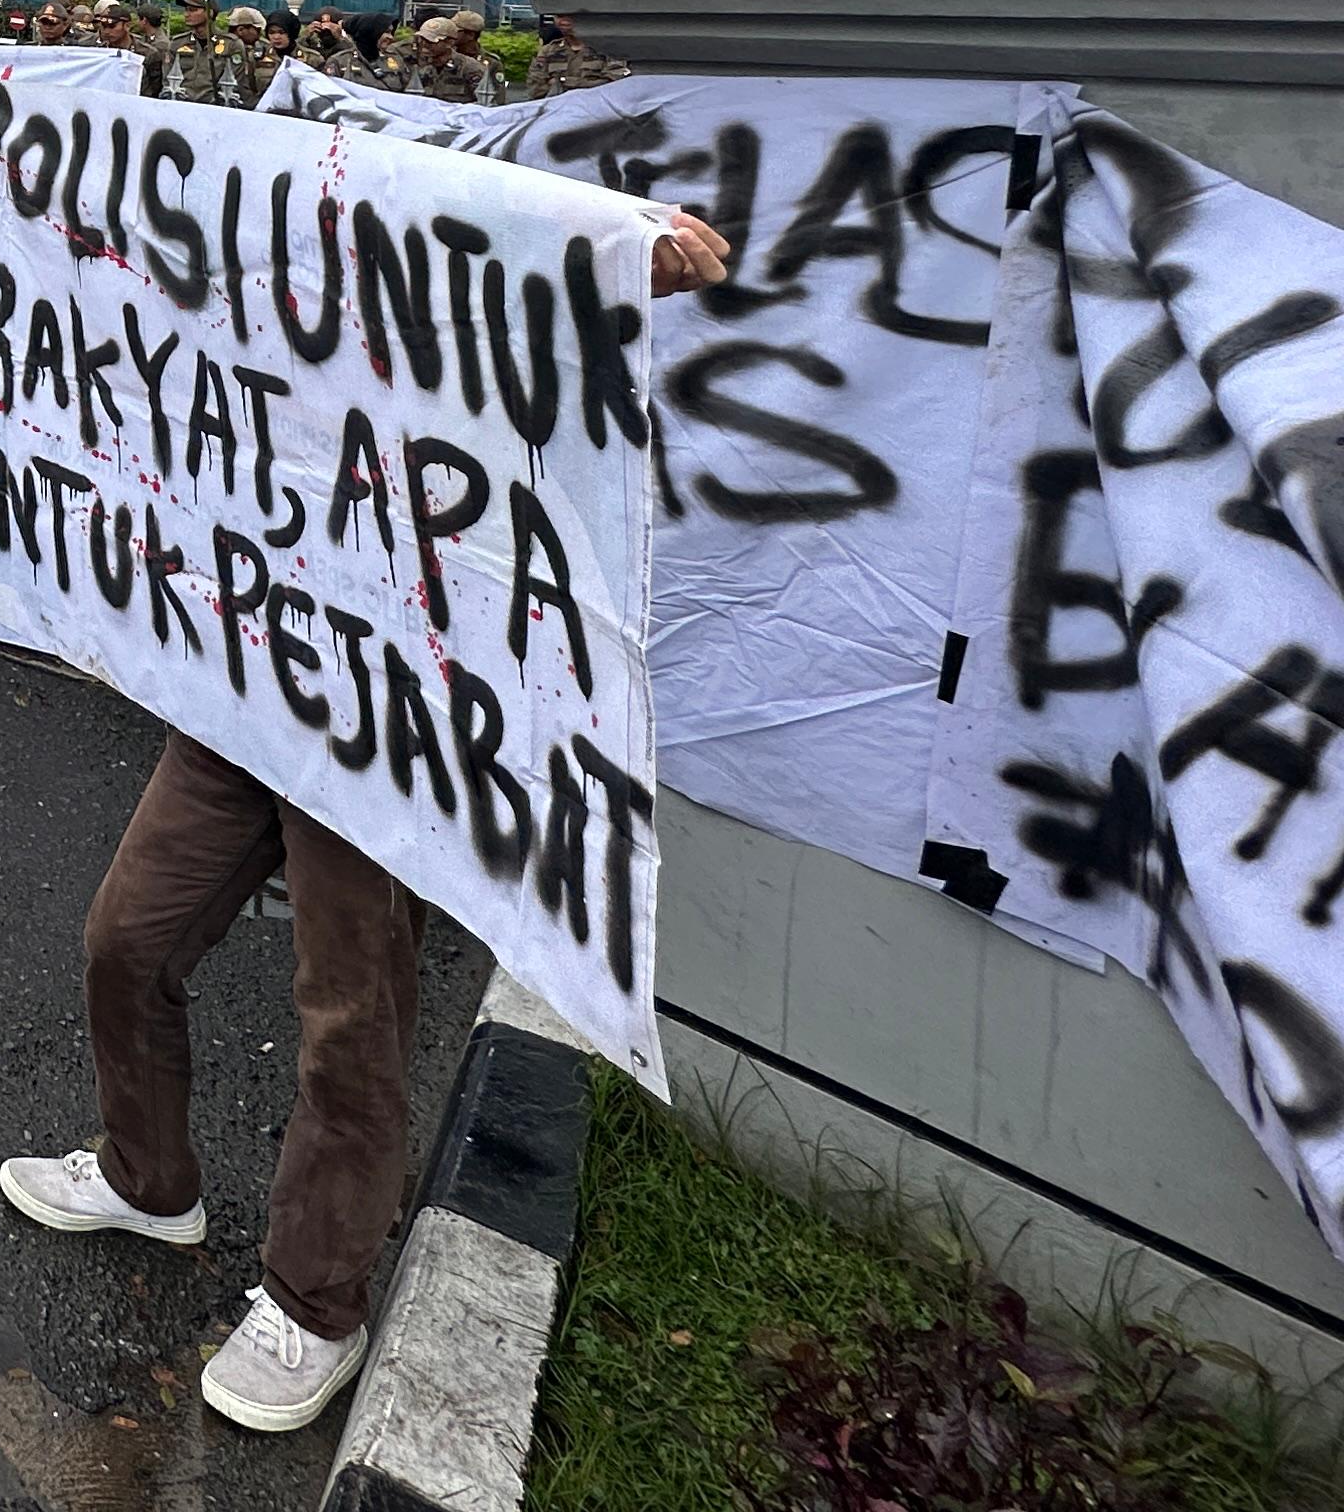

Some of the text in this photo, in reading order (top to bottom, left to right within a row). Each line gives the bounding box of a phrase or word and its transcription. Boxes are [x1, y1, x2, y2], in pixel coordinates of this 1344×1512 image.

[269, 170, 652, 450] UNTUK
[326, 406, 595, 700] APA
[212, 522, 655, 996] PEJABAT
